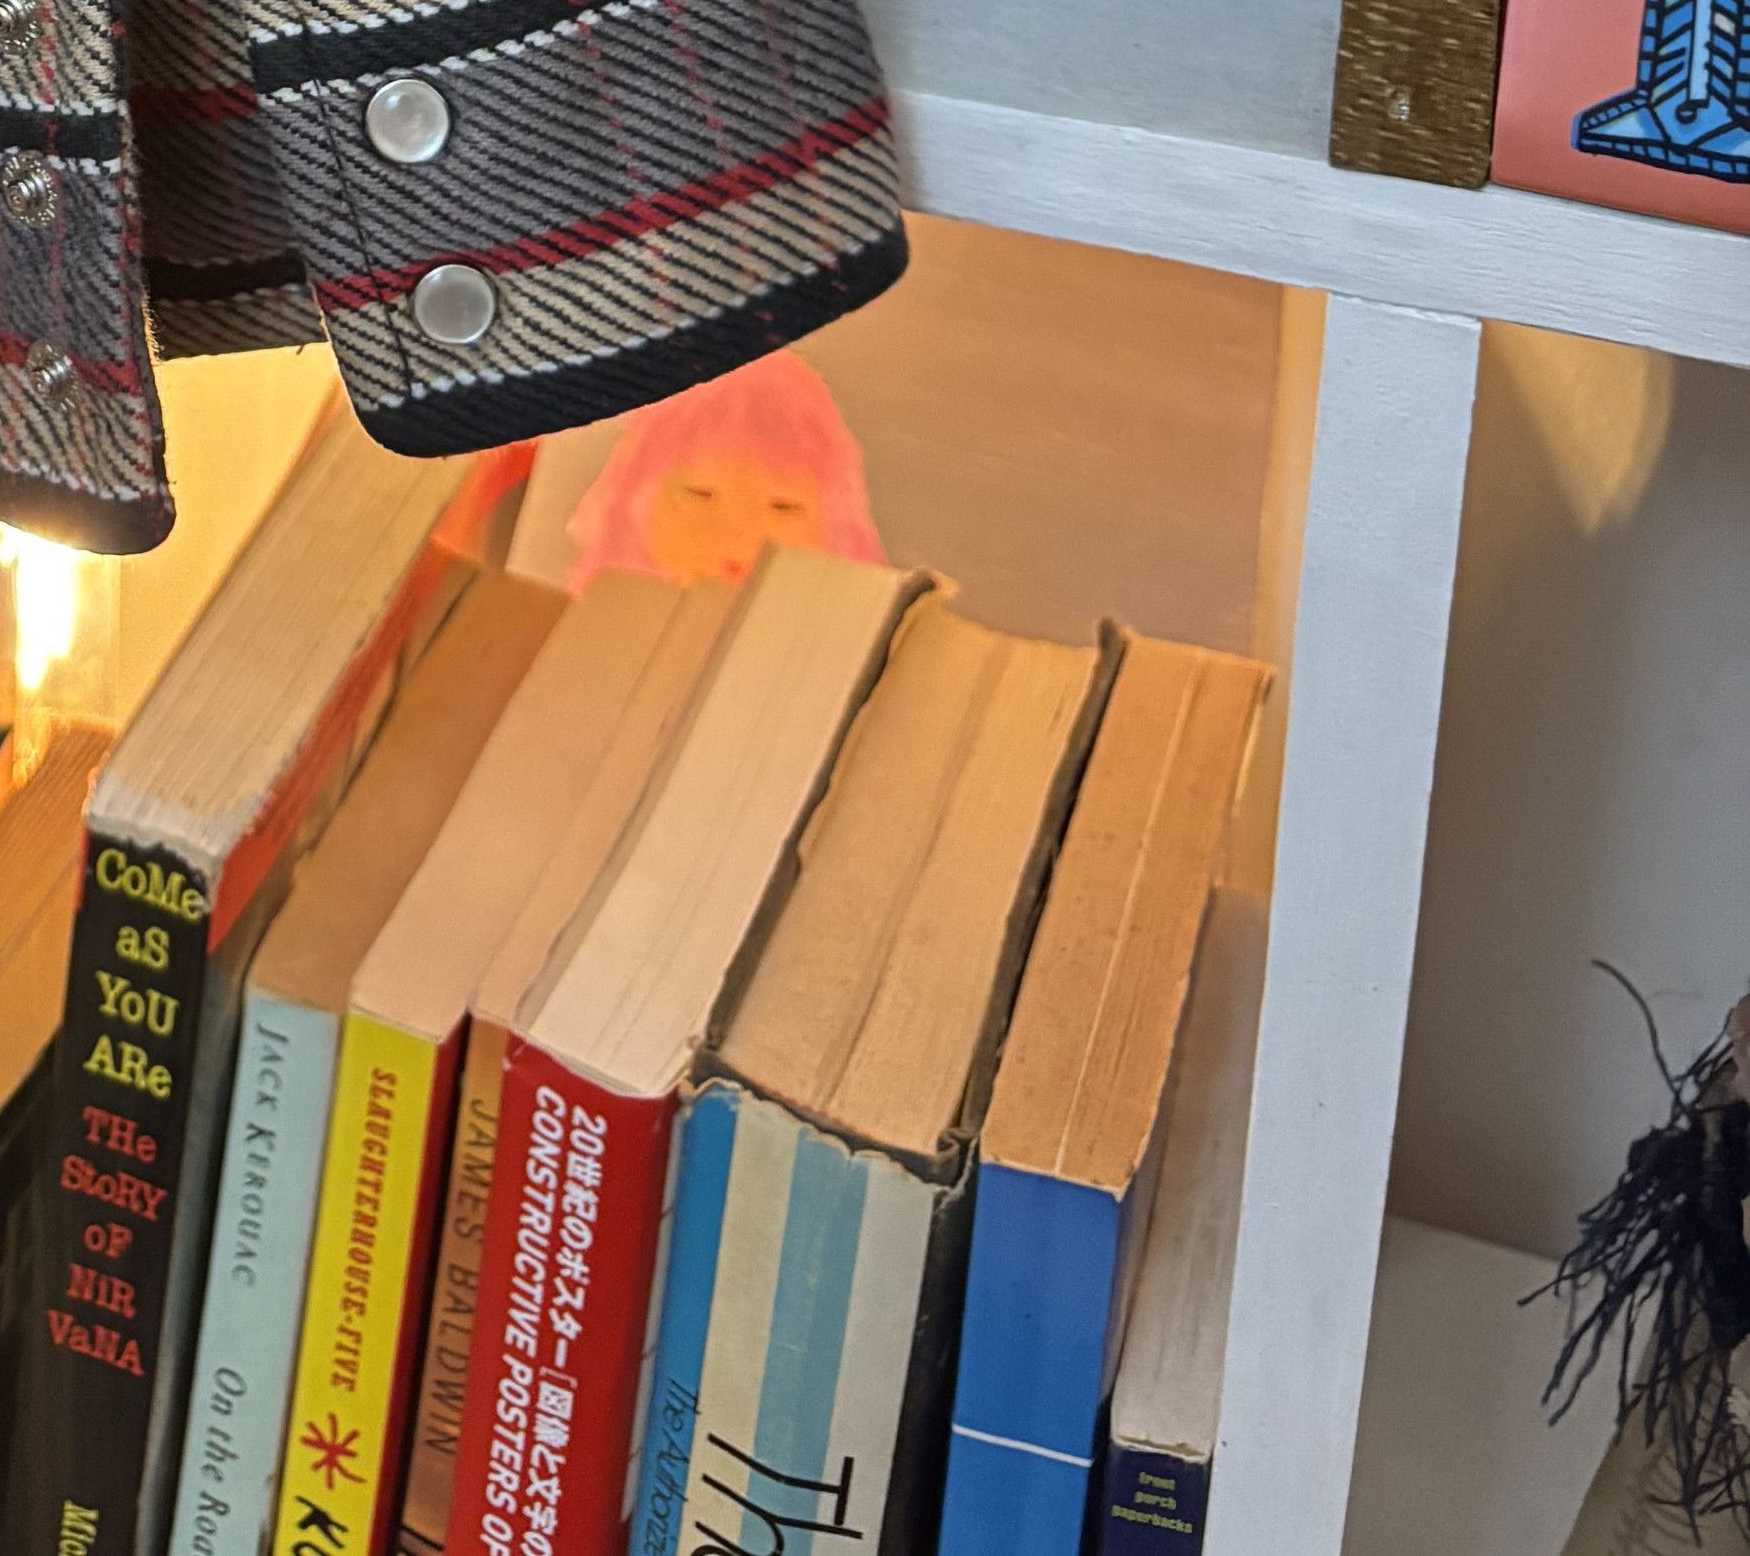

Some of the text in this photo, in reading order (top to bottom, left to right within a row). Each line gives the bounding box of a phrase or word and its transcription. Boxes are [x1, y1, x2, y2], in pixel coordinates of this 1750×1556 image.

[231, 1021, 290, 1287] JACK KEROUAC
[503, 1085, 570, 1359] CONSTRUCTIVE
[425, 1100, 500, 1455] JAMES BALDWIN
[202, 1426, 239, 1483] the
[211, 1367, 246, 1416] On
[486, 1354, 533, 1516] POSTERS
